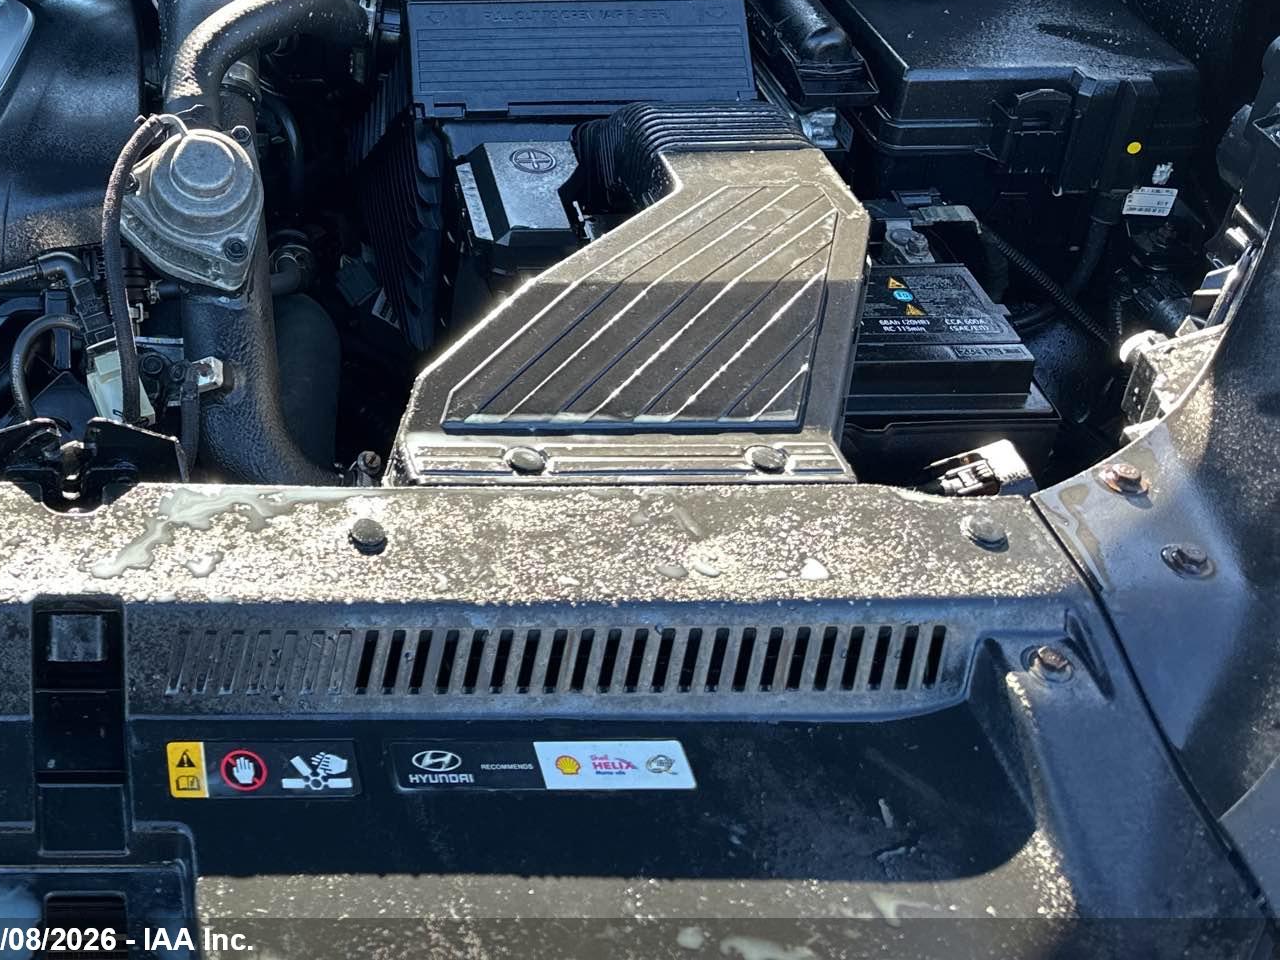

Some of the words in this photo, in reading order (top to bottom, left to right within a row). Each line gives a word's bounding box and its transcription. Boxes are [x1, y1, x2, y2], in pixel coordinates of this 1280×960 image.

[480, 763, 534, 771] RECOMMENDS
[592, 759, 637, 770] HELIX
[408, 773, 475, 783] HYUNDAI
